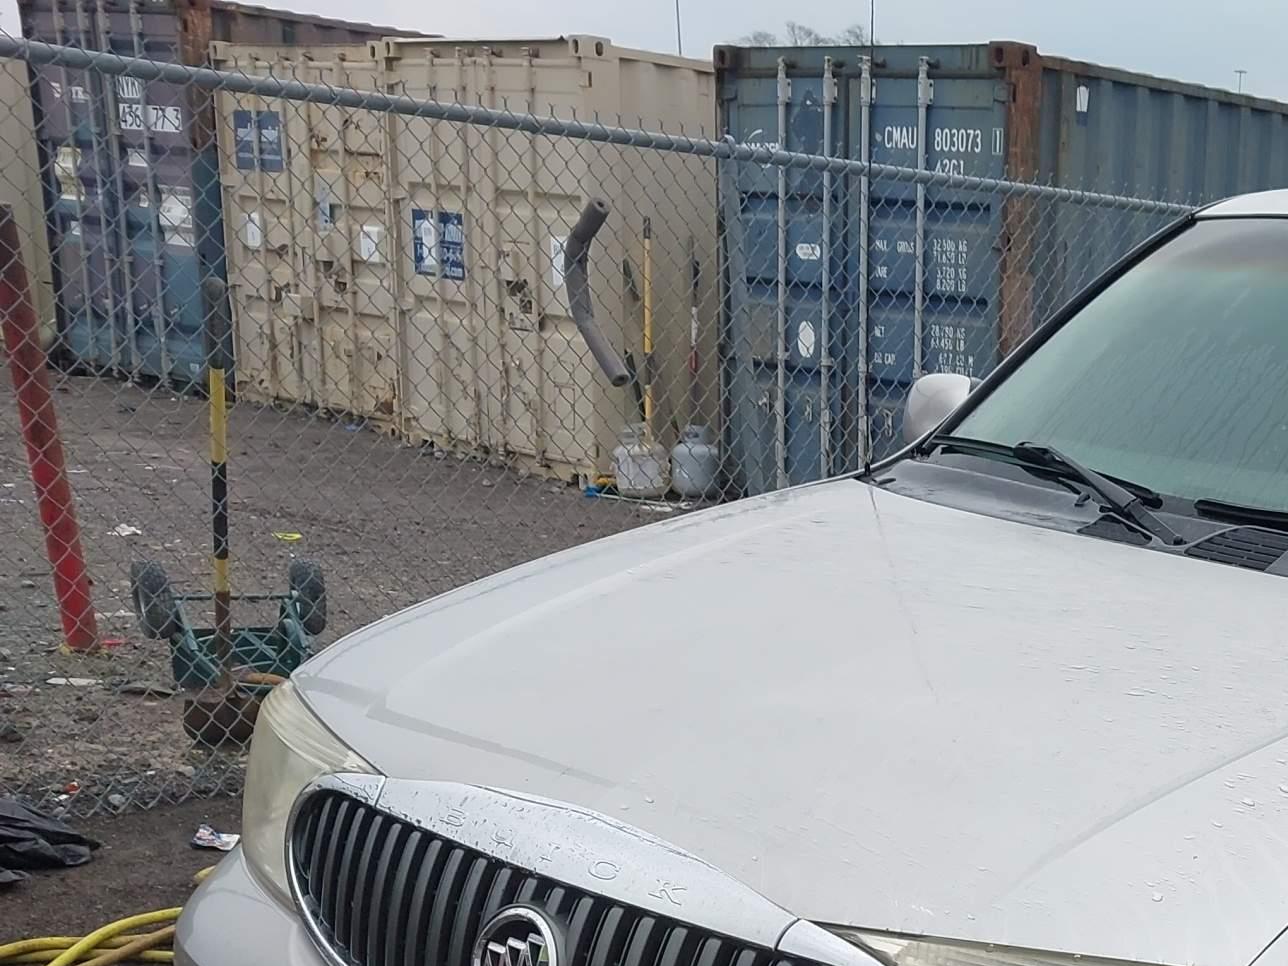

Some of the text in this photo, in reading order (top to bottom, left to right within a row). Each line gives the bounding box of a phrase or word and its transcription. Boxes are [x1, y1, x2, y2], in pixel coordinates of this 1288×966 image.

[884, 126, 917, 149] CMAU
[934, 129, 982, 153] 803073
[439, 807, 688, 906] BUICK
